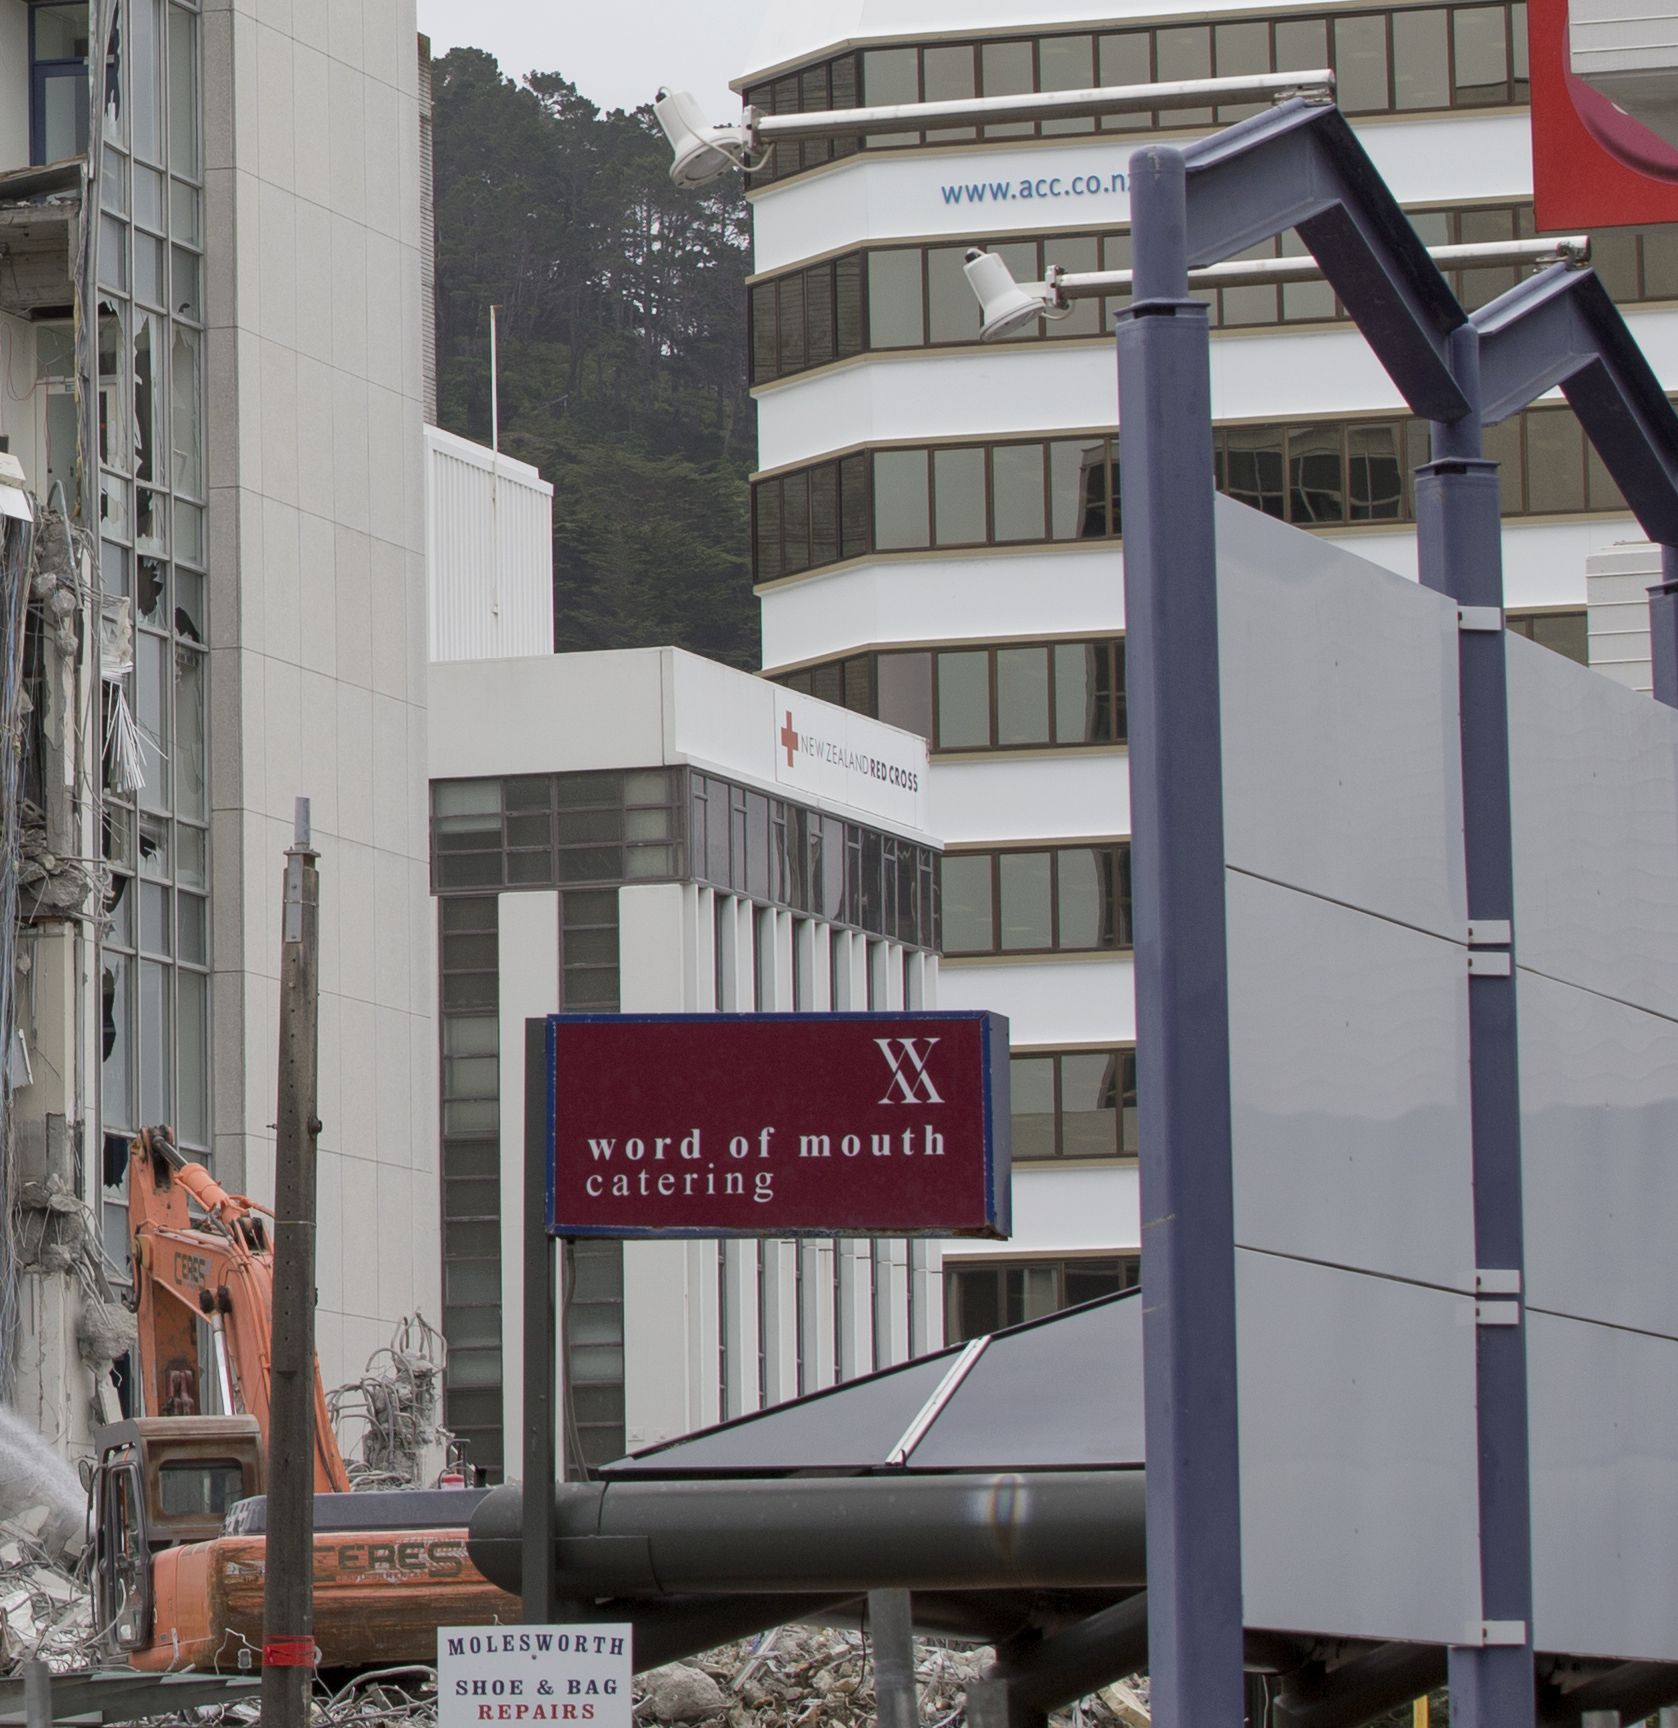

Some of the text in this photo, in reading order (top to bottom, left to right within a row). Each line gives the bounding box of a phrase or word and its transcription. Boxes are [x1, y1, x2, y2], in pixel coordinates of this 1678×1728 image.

[941, 173, 1130, 204] www.acc.co.n
[800, 734, 919, 793] NEW ZEALAND RED CROSS
[587, 1124, 946, 1161] word of mouth
[586, 1163, 775, 1203] catering
[447, 1633, 625, 1657] MOLESWORTH
[455, 1678, 618, 1696] SHOE & BAG
[477, 1703, 596, 1720] REPAIRS
